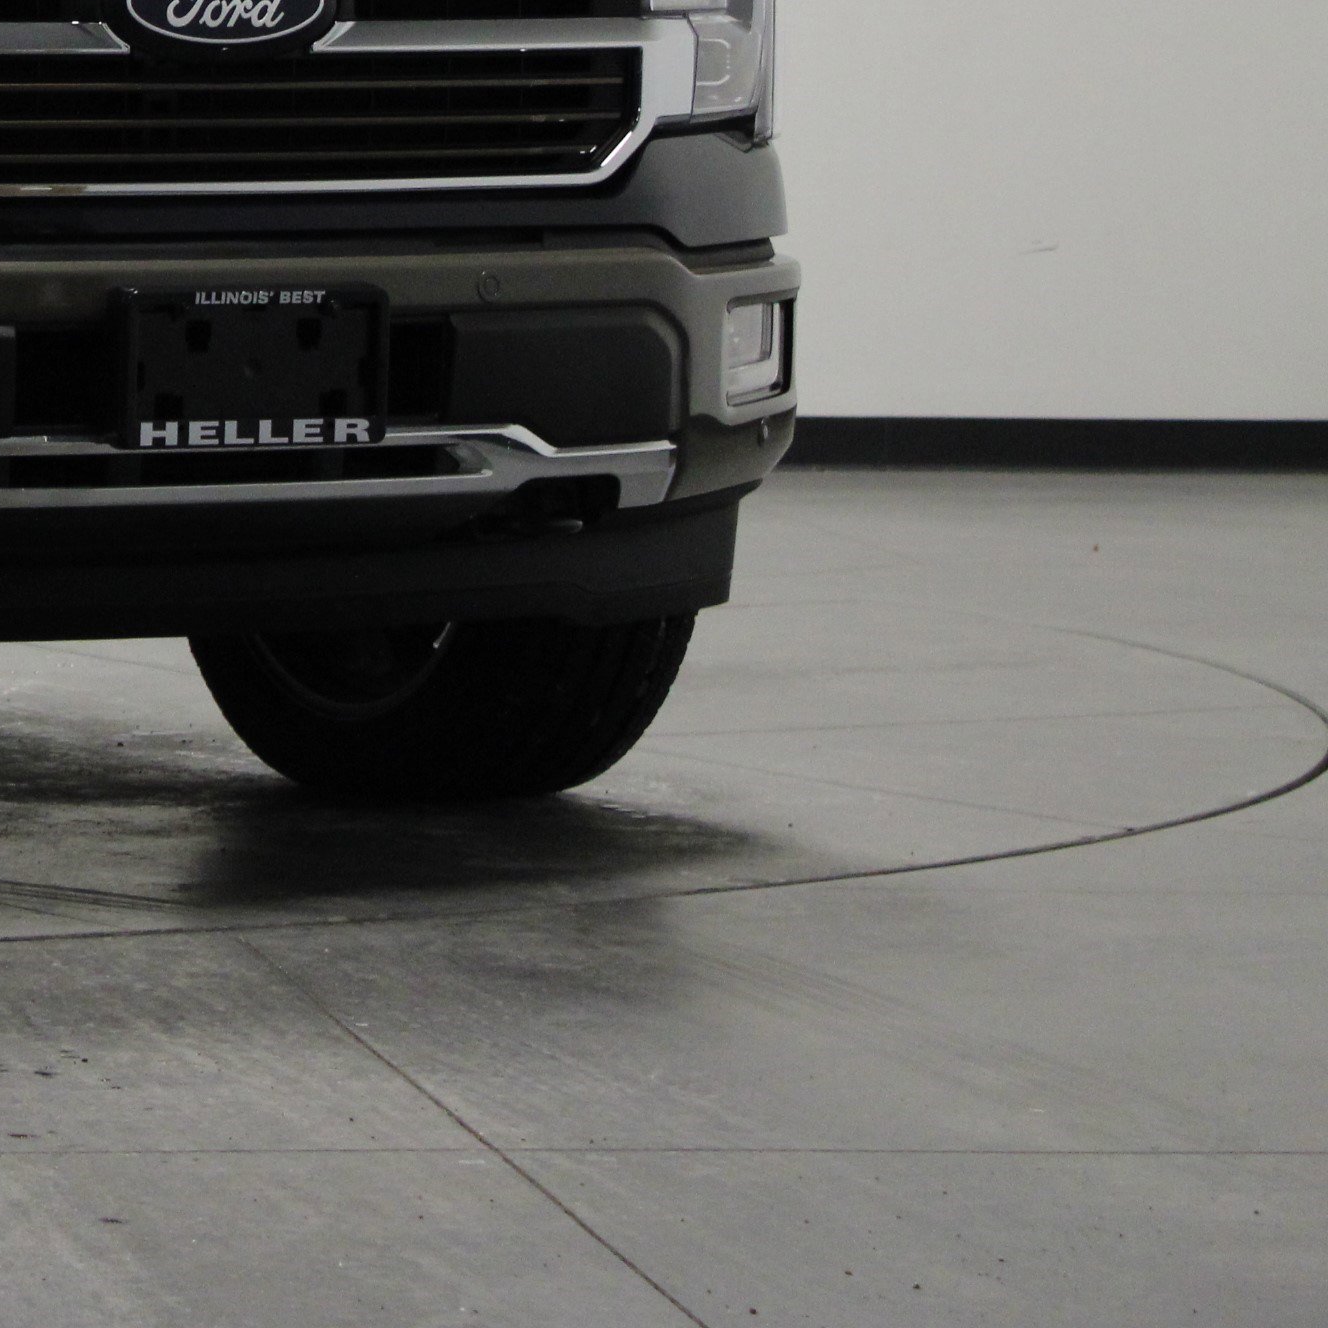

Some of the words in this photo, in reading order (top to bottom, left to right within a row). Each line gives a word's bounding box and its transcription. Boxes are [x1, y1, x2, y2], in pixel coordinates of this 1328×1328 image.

[195, 291, 274, 305] ILLINOIS'
[279, 290, 326, 304] BEST
[139, 418, 370, 447] HELLER
